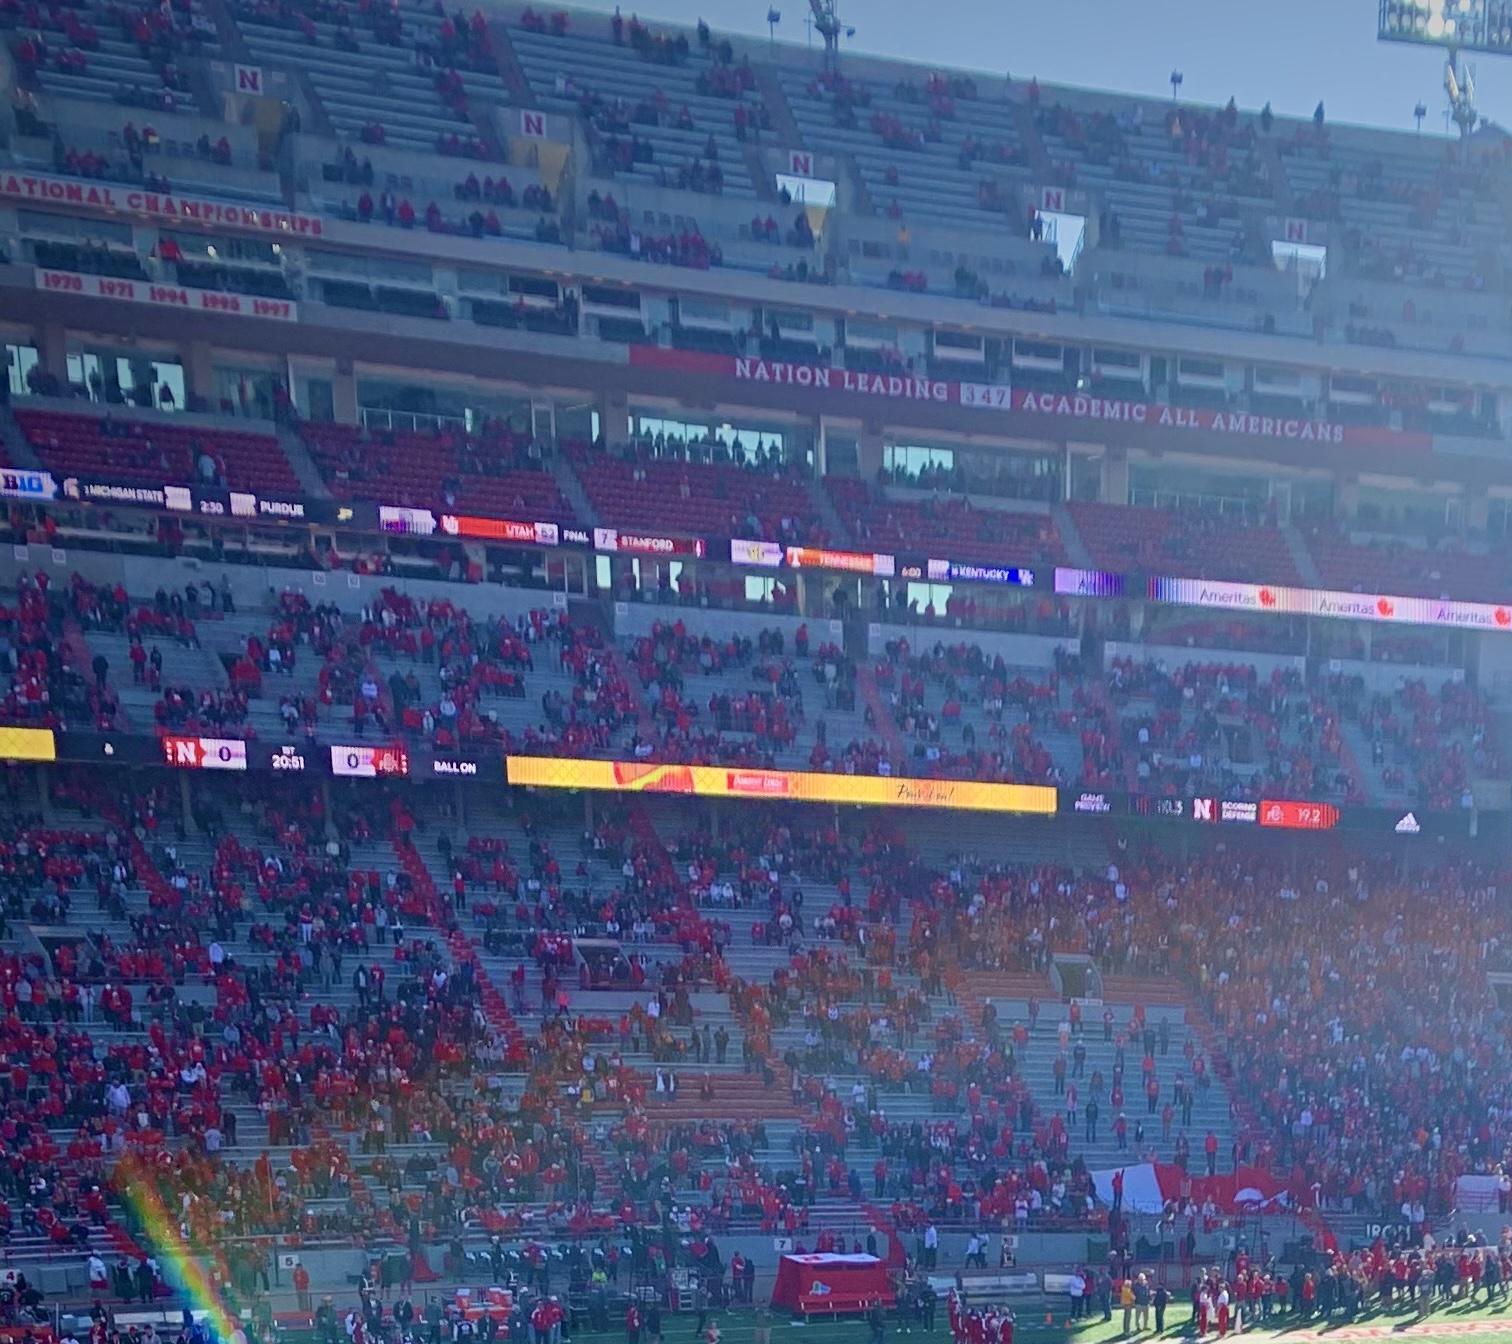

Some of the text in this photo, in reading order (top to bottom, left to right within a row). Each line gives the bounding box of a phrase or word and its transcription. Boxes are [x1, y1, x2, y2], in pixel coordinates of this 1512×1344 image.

[239, 68, 259, 91] N
[523, 112, 544, 136] N
[792, 154, 811, 175] N
[0, 175, 323, 235] ATIONAL CHAMPIONSHIPS
[1045, 191, 1062, 210] N
[98, 279, 135, 298] 1971
[734, 357, 831, 387] NATION
[843, 372, 949, 401] LEADING
[1022, 391, 1147, 423] ACADEMIC
[1158, 407, 1200, 428] ALL
[1212, 413, 1345, 443] AMERICANS
[90, 484, 136, 499] MICHIGAN
[136, 488, 165, 503] STATE
[260, 501, 304, 517] PURDUE
[505, 525, 535, 539] UTAH
[563, 529, 590, 543] FINAL
[620, 535, 674, 552] STANFORD
[958, 565, 1009, 581] KENTUCKY
[1200, 588, 1258, 606] Ameritas
[1319, 598, 1375, 616] Ameritas
[1437, 607, 1493, 625] Ameritas
[175, 741, 197, 763] N
[219, 746, 232, 762] 0
[347, 753, 359, 769] 0
[433, 760, 477, 775] BALL ON
[1193, 798, 1212, 820] N
